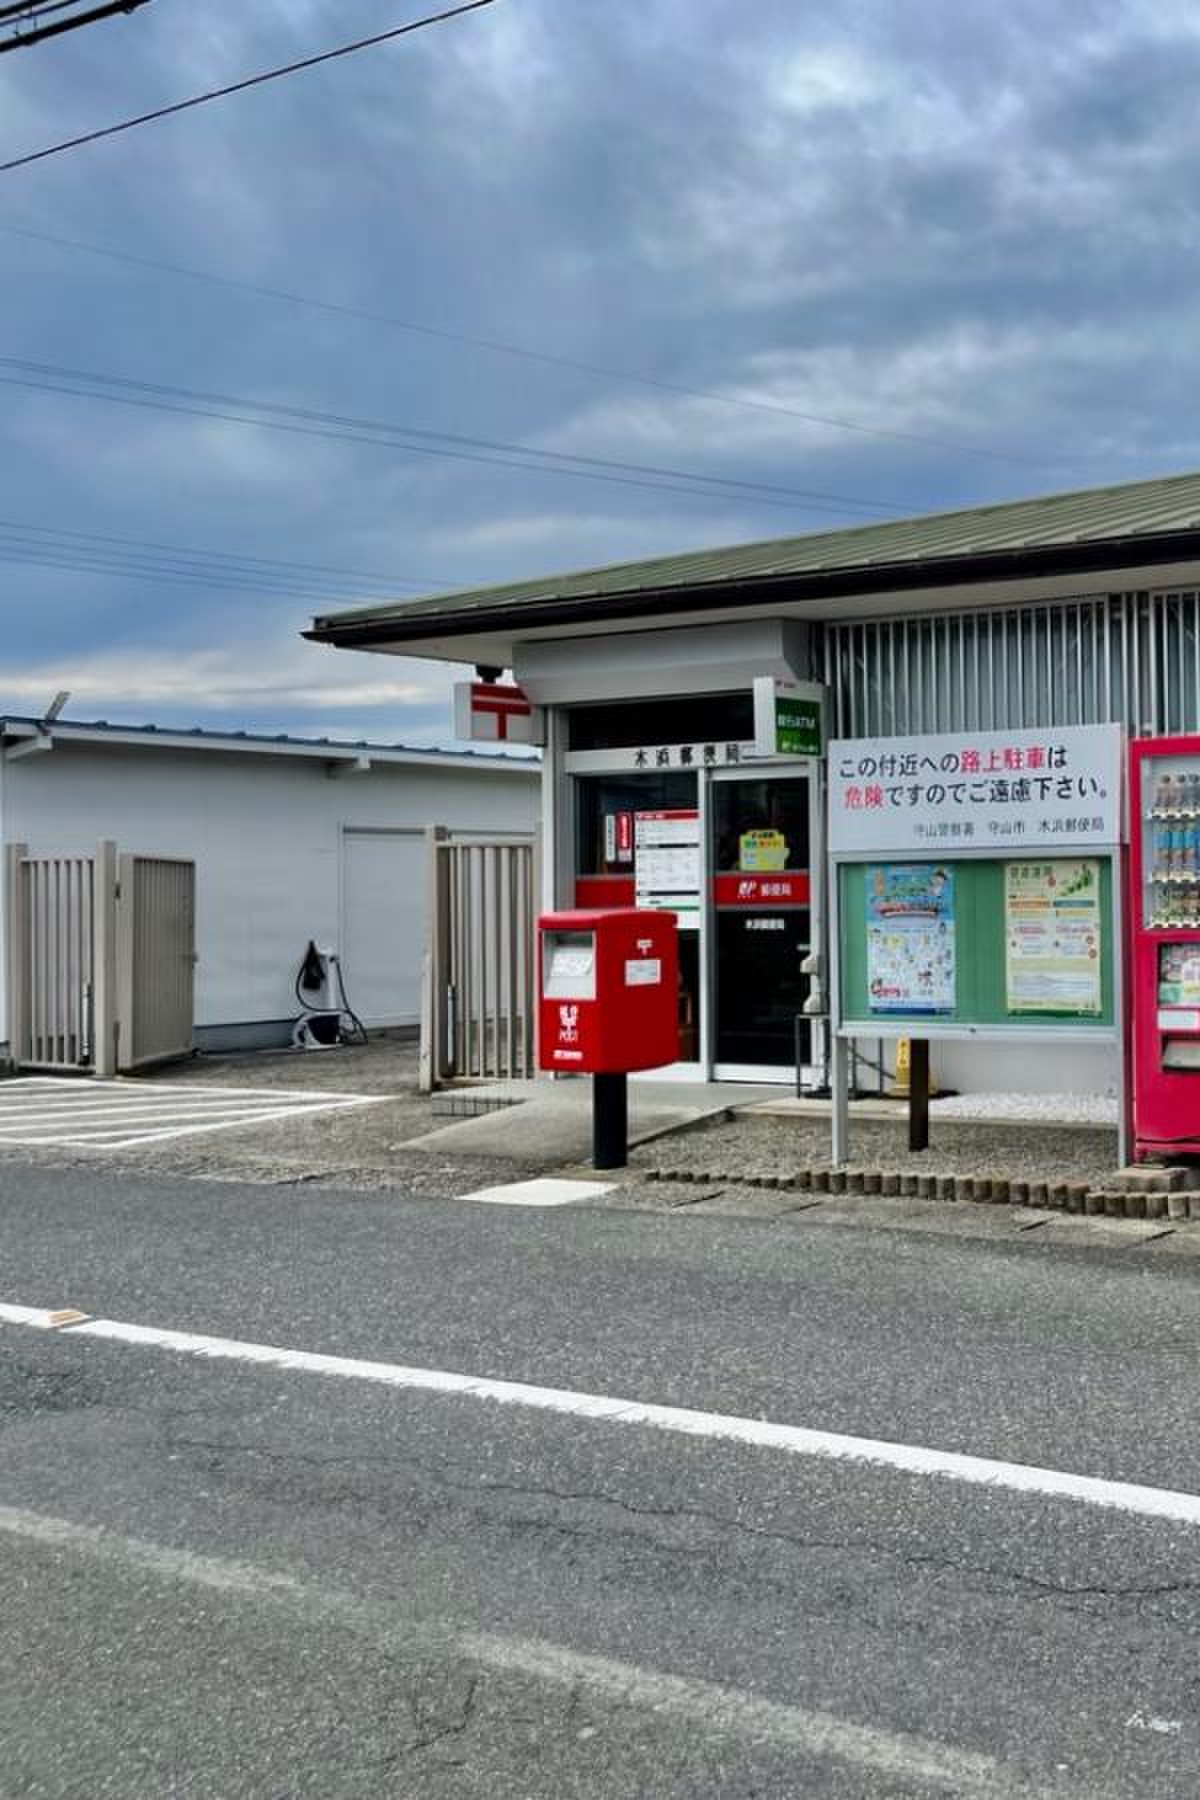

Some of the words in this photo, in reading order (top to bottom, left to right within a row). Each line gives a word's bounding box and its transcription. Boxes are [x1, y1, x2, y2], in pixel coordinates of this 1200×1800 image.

[839, 746, 1067, 778] この付近への路上駐車は
[844, 776, 1107, 810] 危険ですのでご遠慮下さい。
